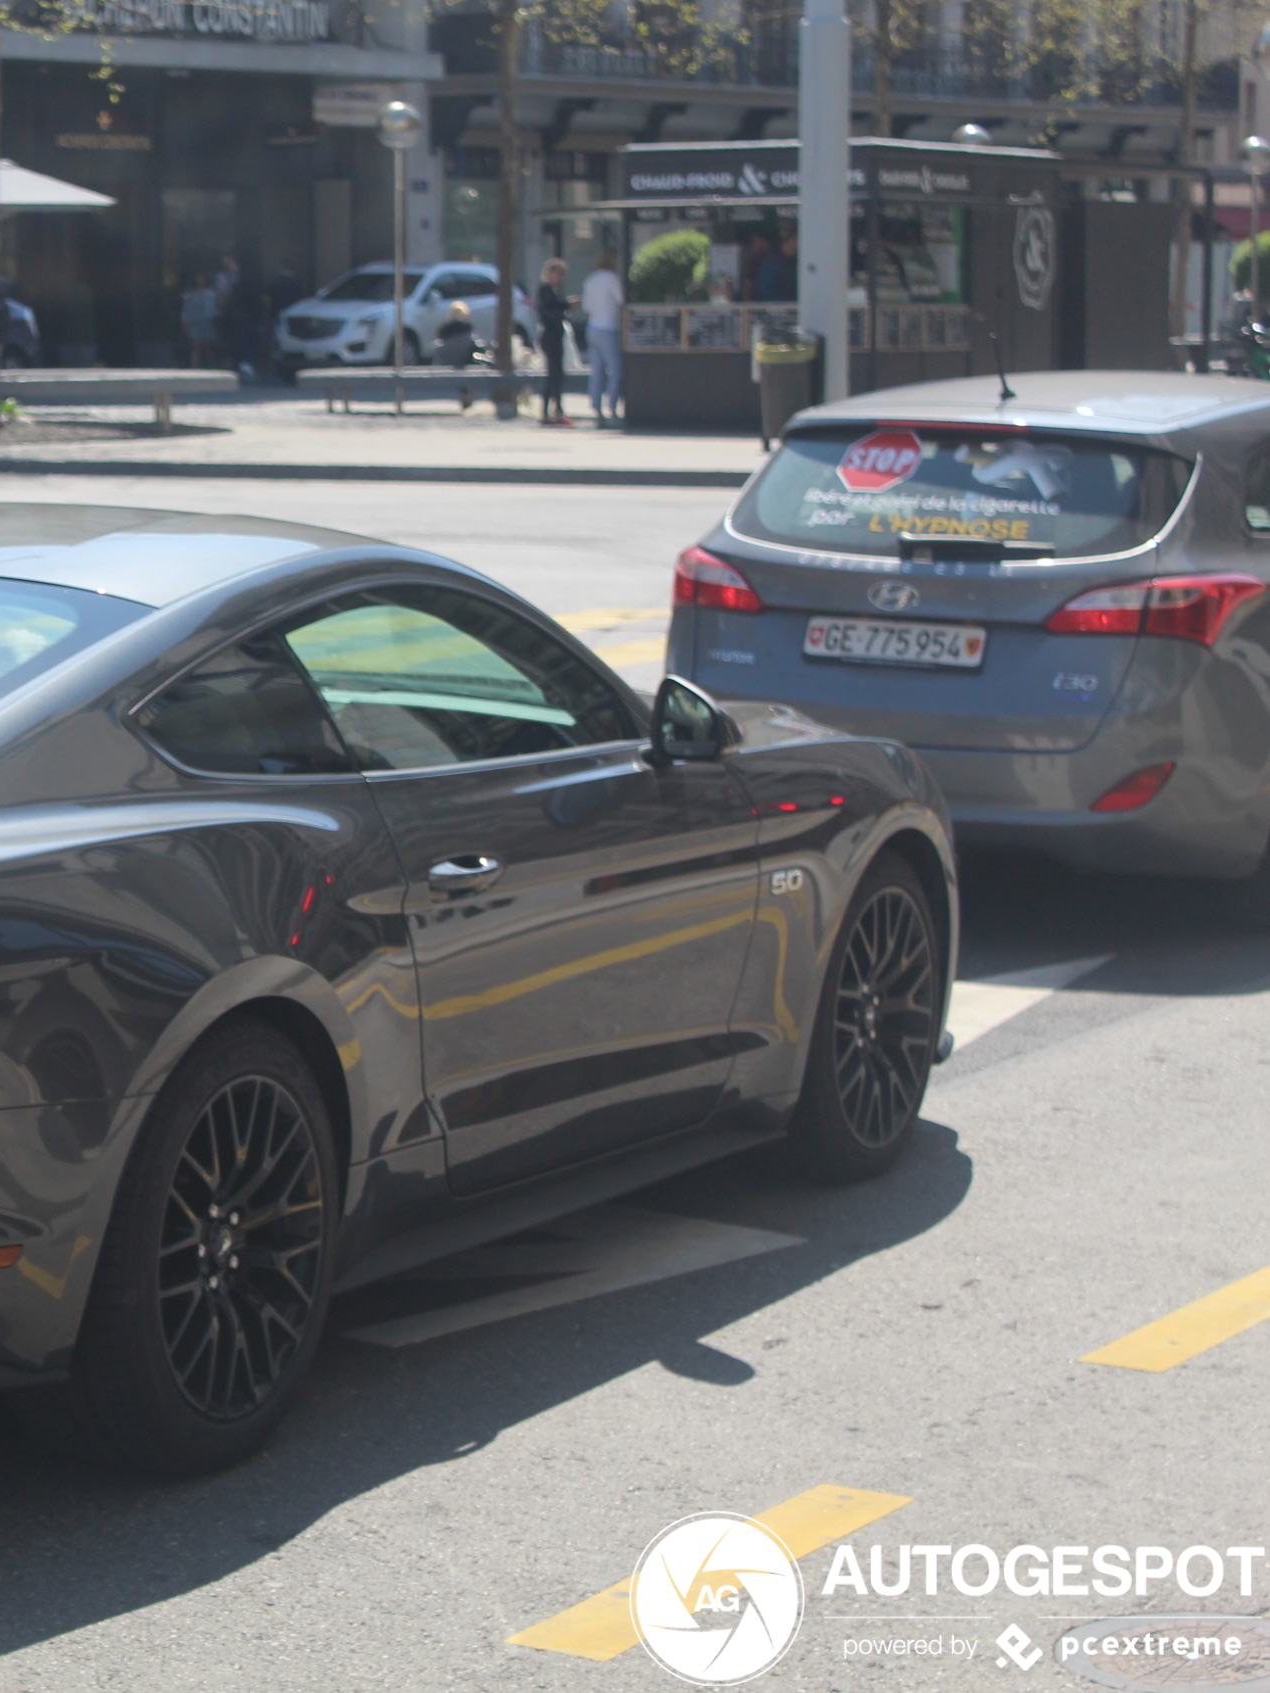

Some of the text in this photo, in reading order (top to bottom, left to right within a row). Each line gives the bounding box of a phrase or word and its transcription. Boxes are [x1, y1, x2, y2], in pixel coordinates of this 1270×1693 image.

[845, 447, 916, 474] STOP
[921, 495, 947, 511] de
[949, 496, 968, 512] la
[970, 496, 1061, 517] cigarette
[807, 509, 1029, 539] par L'HYPNOSE
